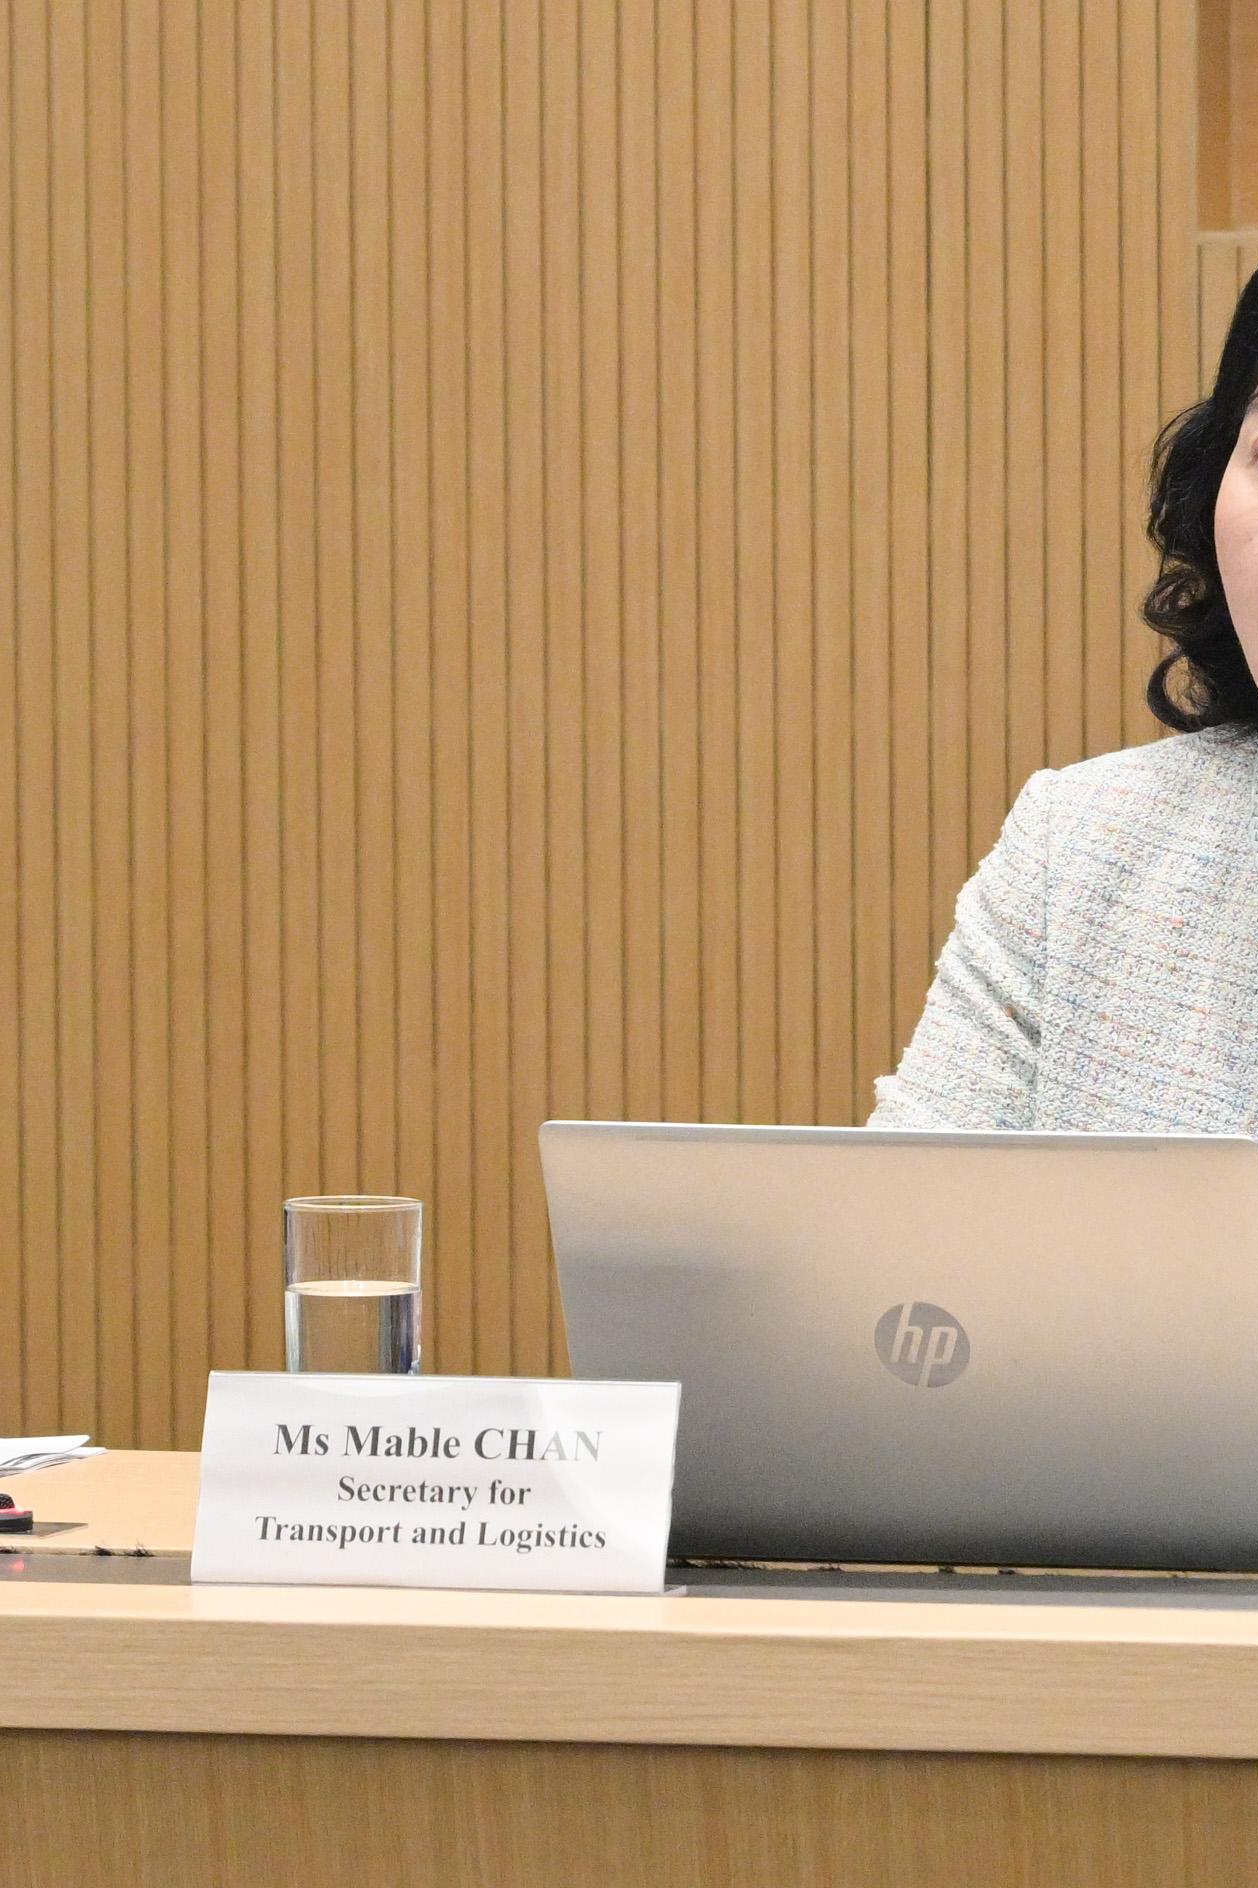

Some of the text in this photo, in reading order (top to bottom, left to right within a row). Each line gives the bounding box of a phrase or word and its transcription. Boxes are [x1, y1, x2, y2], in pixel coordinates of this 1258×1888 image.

[889, 1301, 959, 1388] hp
[272, 1423, 603, 1463] Ms Mable CHAN
[337, 1475, 532, 1512] Secretary for
[254, 1515, 607, 1555] Transport and Logistics
